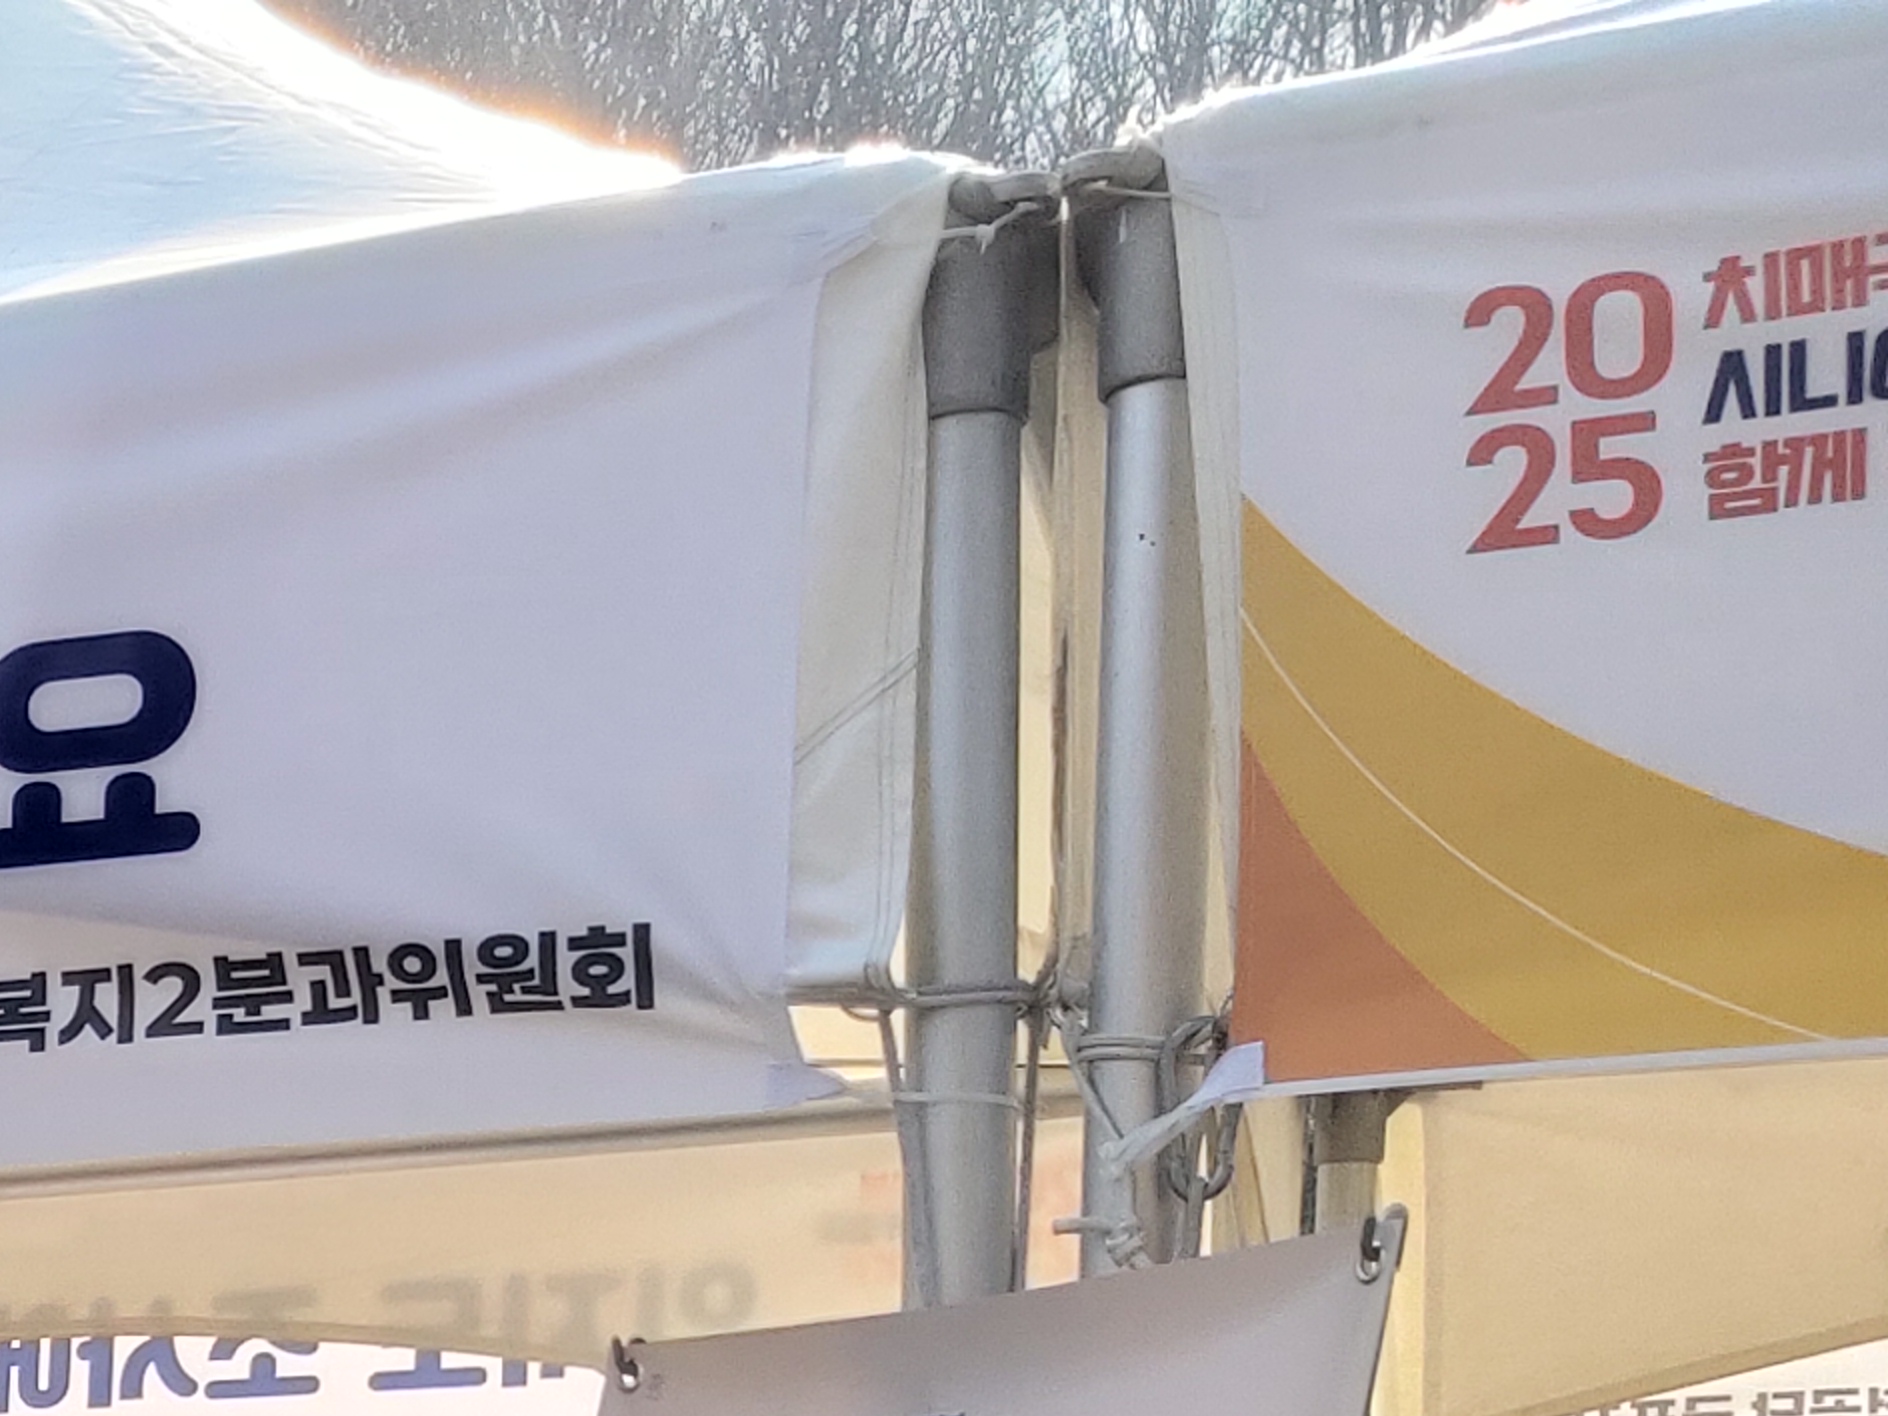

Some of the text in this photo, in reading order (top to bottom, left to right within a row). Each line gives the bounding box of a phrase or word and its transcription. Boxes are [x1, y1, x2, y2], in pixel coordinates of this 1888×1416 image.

[1463, 270, 1675, 417] 20
[1465, 410, 1663, 554] 25
[1702, 427, 1868, 521] 함께
